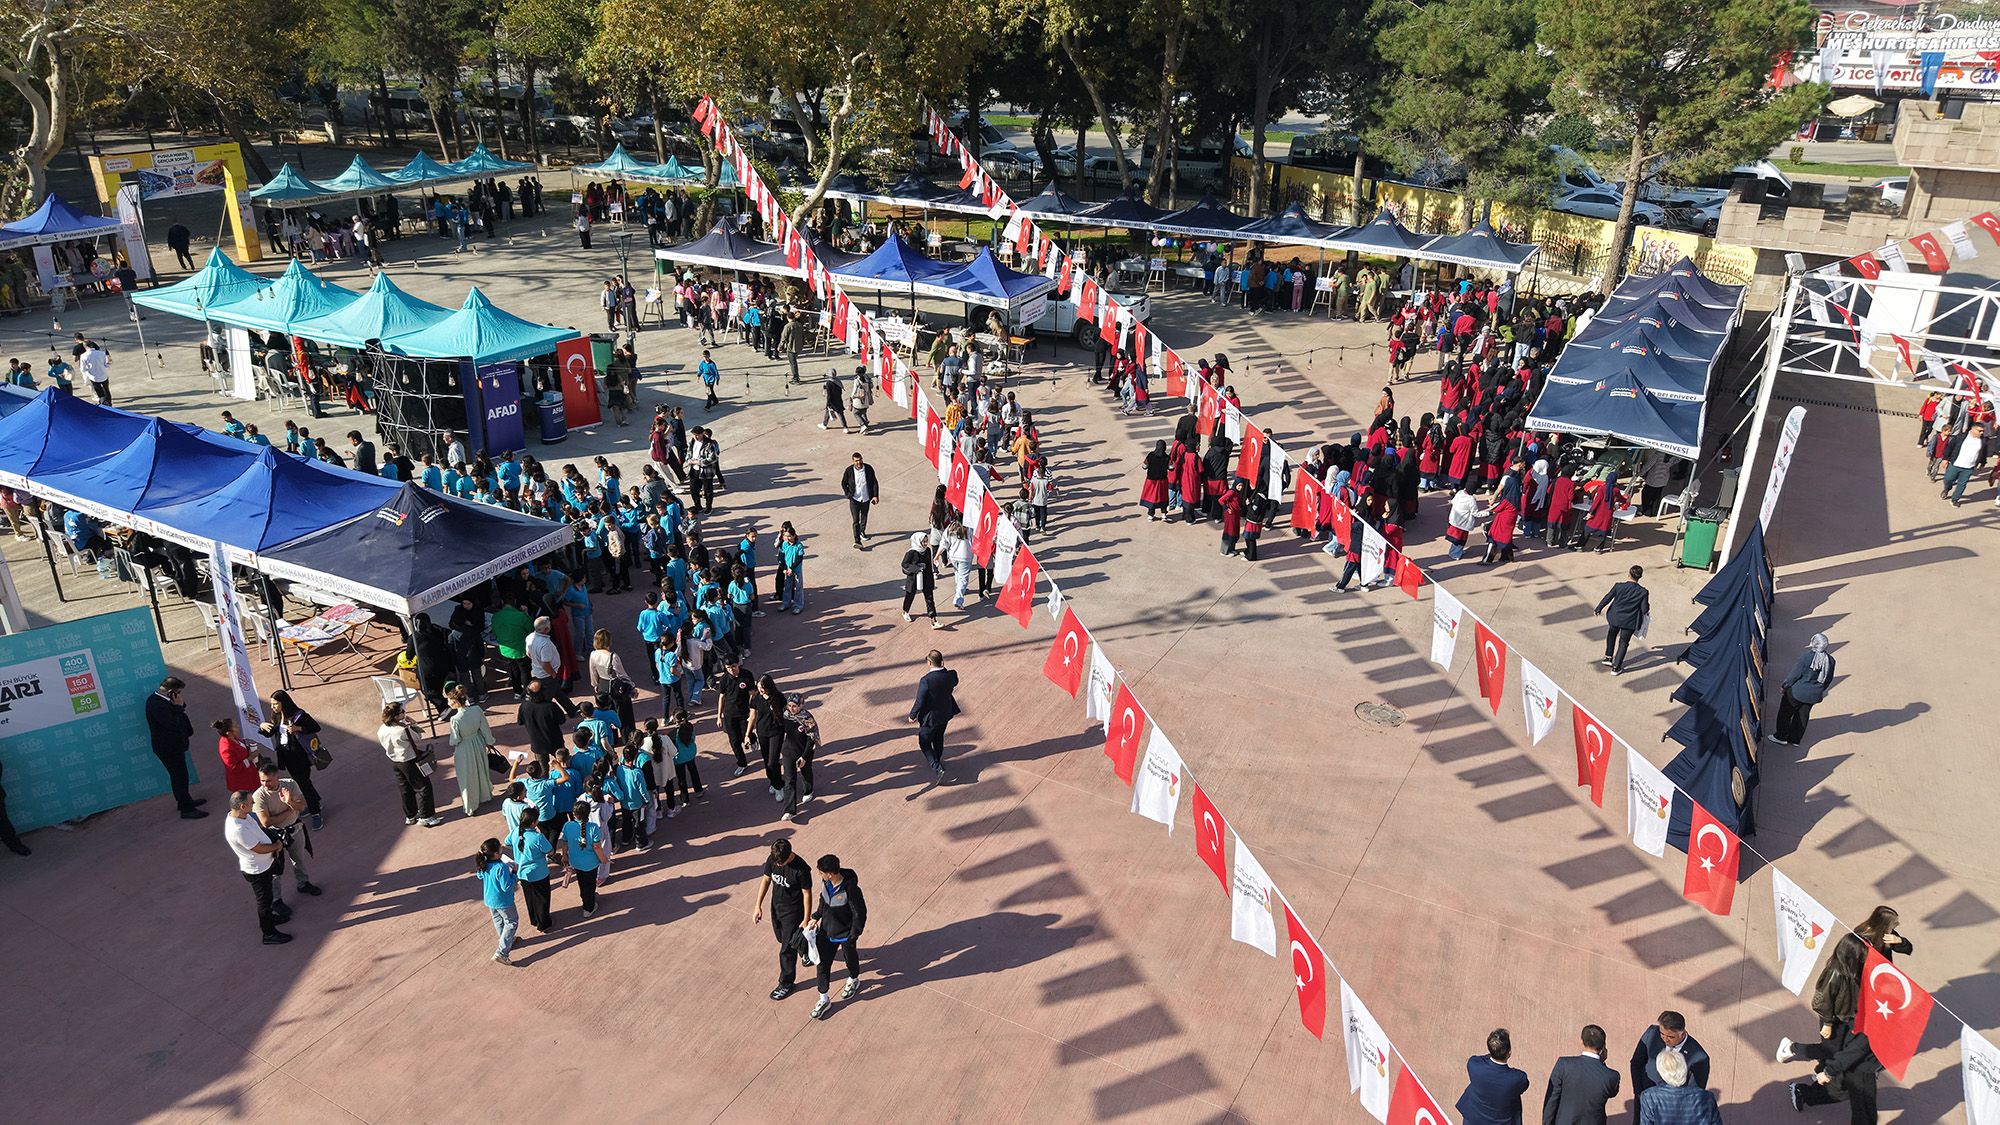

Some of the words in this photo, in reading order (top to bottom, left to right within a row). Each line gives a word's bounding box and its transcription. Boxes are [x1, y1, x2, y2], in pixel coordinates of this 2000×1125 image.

[488, 404, 518, 420] AFAD
[421, 569, 485, 605] KAHRAMANMARAŞ
[486, 551, 527, 578] BÜYÜKŞEHİR
[527, 532, 564, 557] BELEDİYESİ
[65, 657, 83, 668] 400
[3, 678, 13, 686] EN
[13, 672, 38, 684] BÜYÜK
[72, 677, 88, 687] 150
[80, 697, 92, 706] 50
